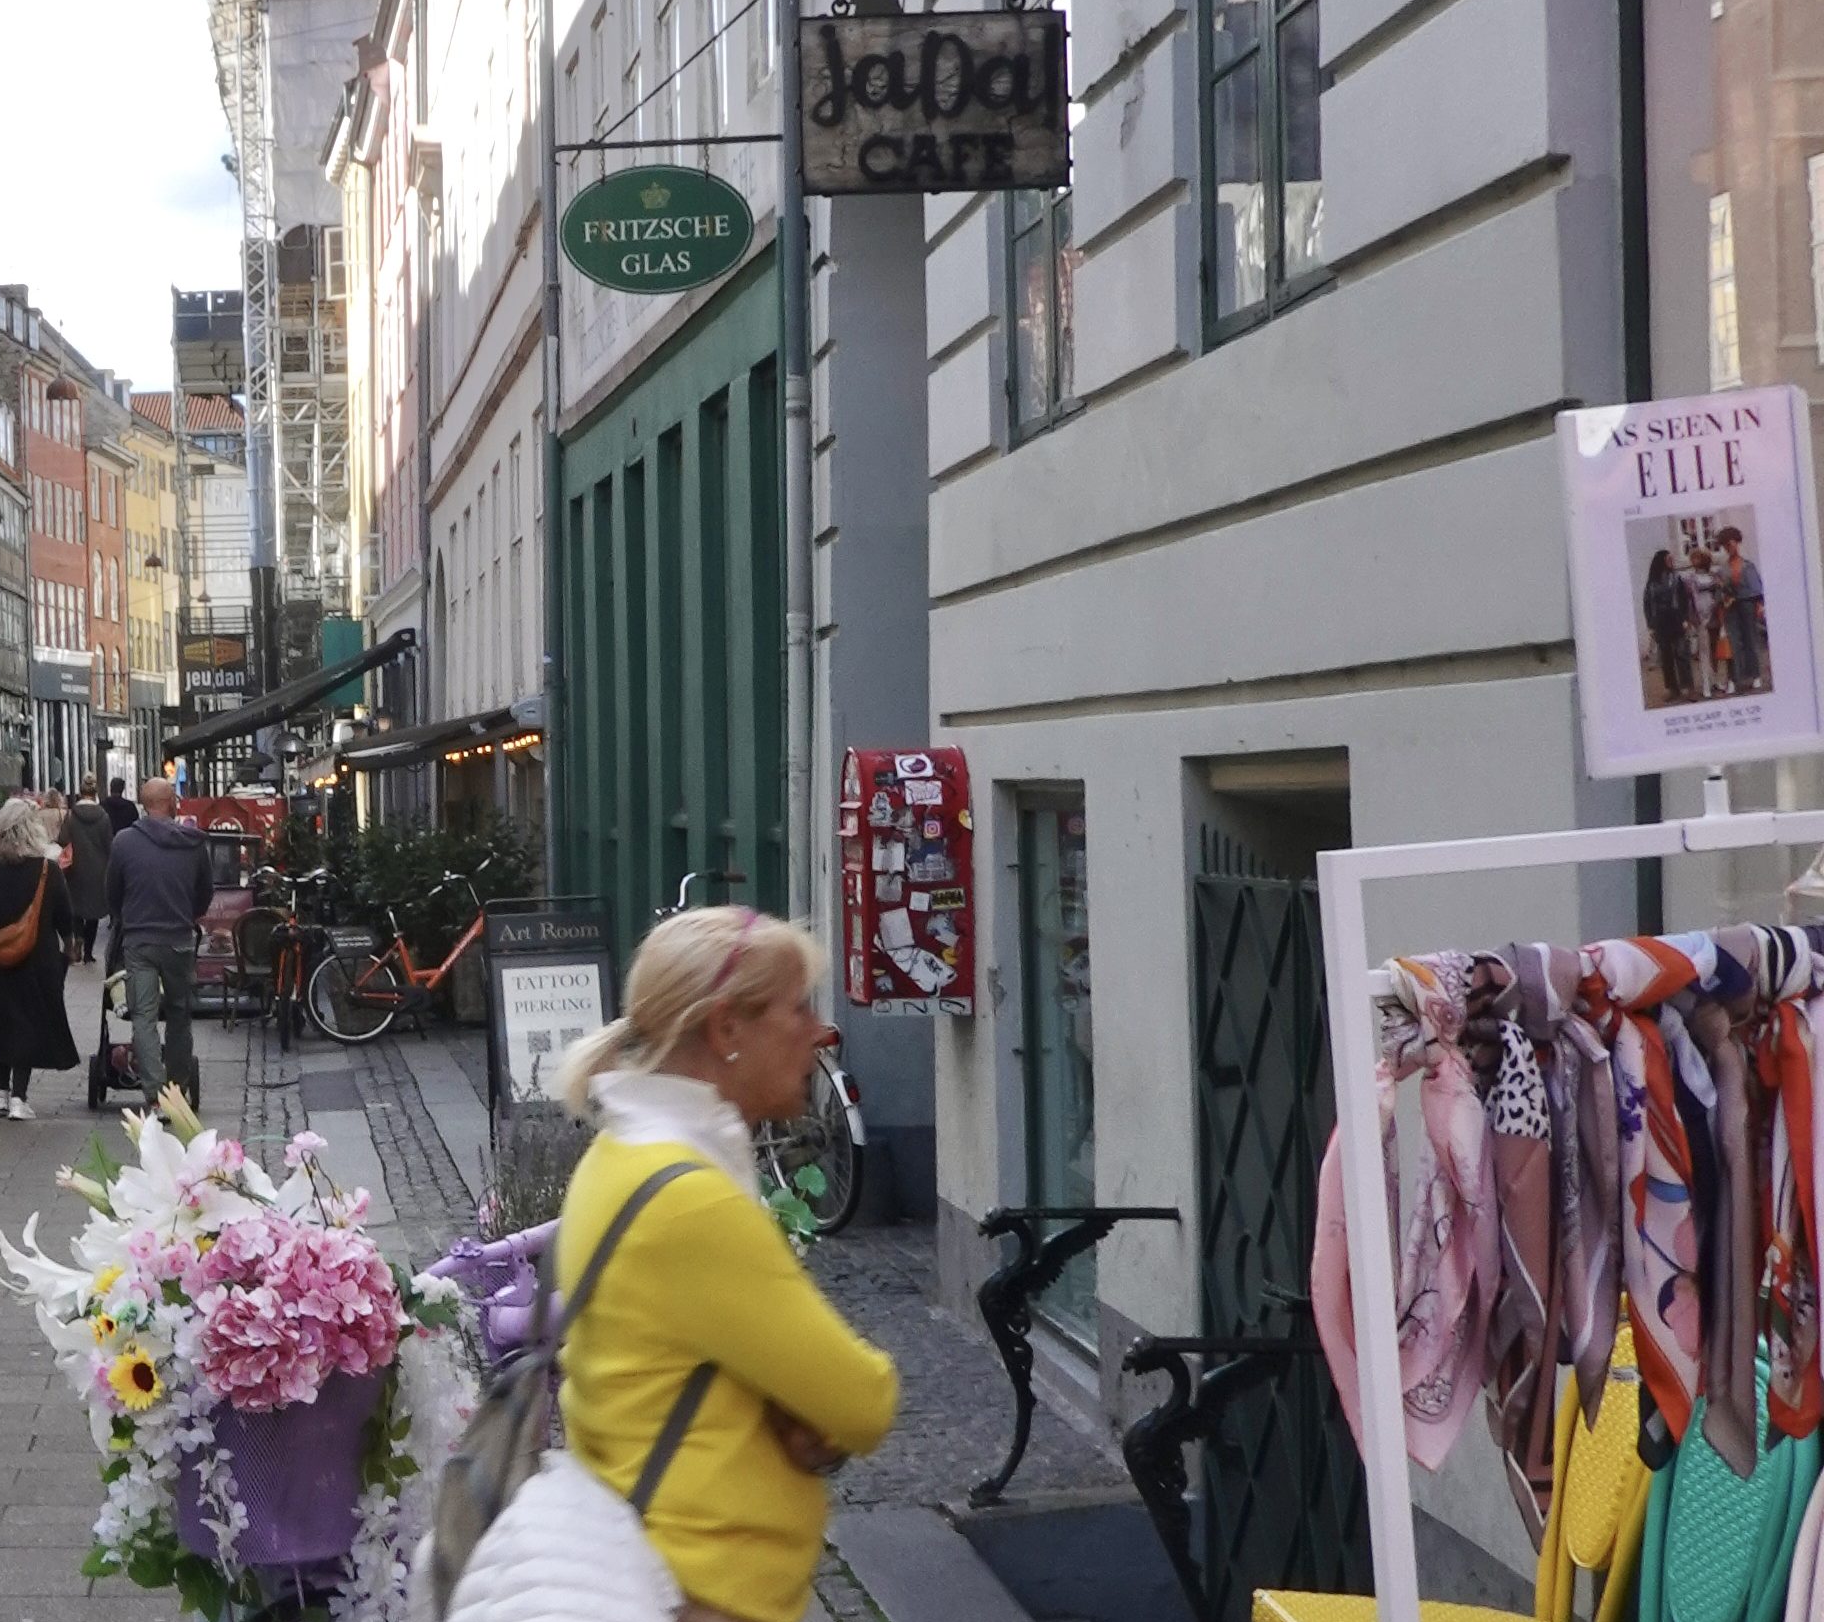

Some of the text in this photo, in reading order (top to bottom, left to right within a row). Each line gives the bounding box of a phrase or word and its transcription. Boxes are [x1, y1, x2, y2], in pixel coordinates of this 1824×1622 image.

[584, 214, 731, 244] FRITZSCHE
[620, 250, 691, 276] GLAS
[1647, 411, 1724, 444] SEEN
[1732, 405, 1761, 431] IN
[1636, 438, 1746, 499] ELLE
[498, 921, 601, 942] Art Room
[515, 973, 591, 991] TATTOO
[514, 997, 592, 1014] PIERCING
